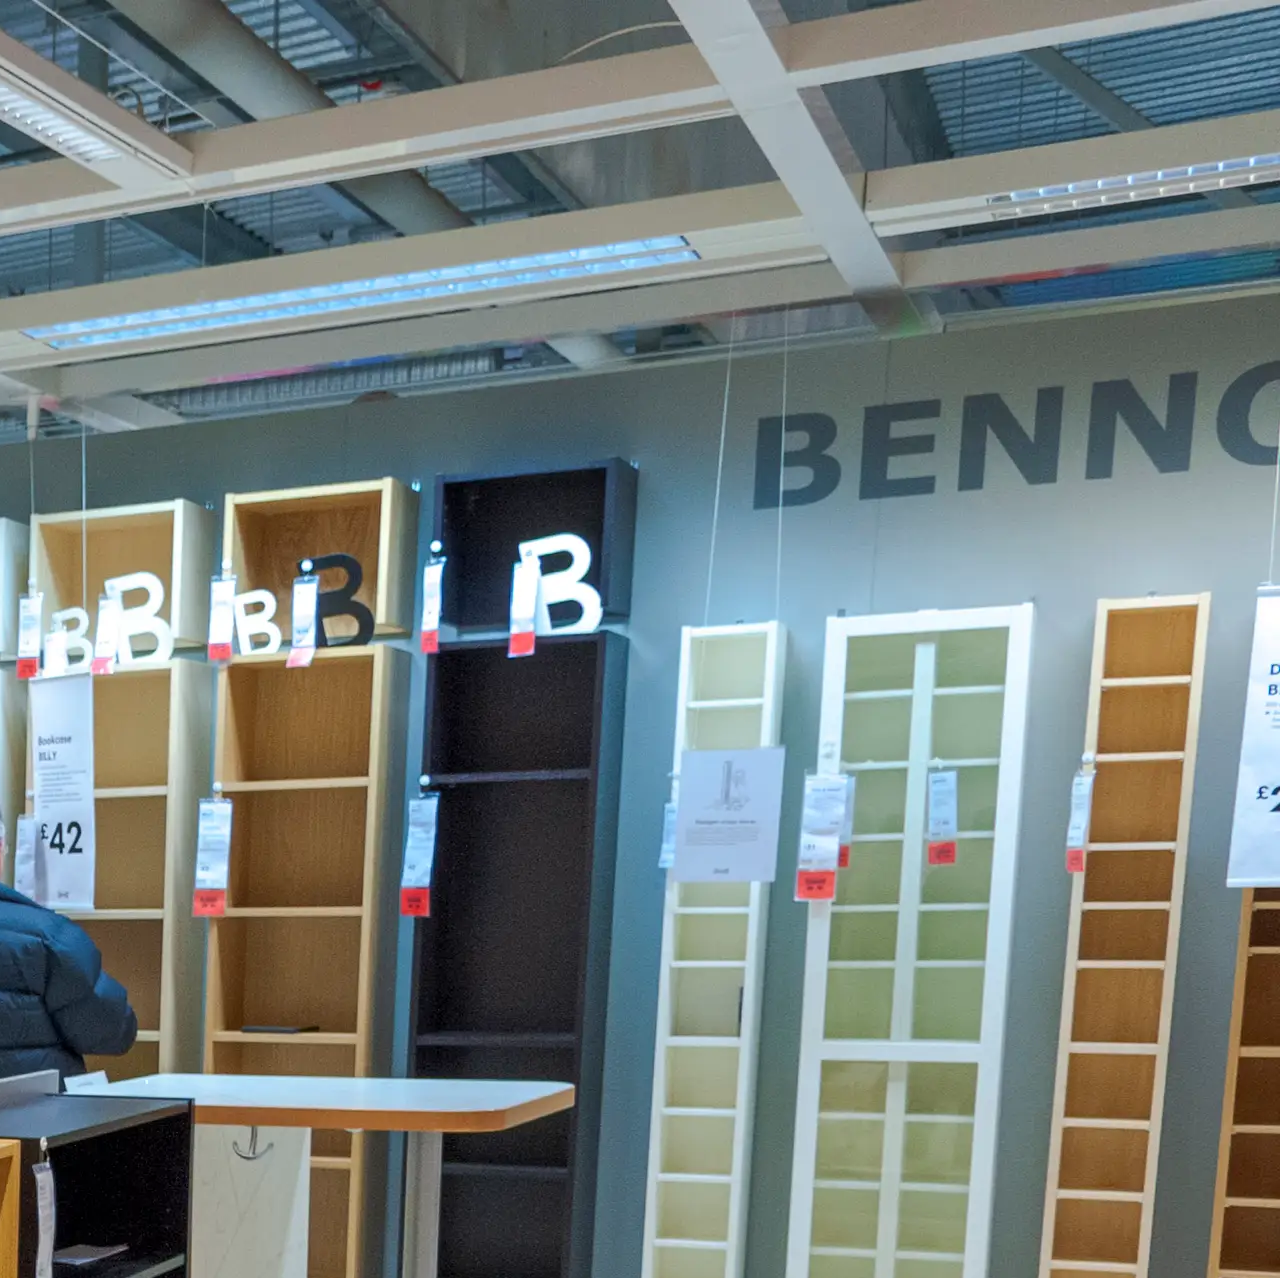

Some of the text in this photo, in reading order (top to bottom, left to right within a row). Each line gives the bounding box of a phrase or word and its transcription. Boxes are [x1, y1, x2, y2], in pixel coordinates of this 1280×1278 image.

[1268, 683, 1280, 696] B
[38, 735, 72, 746] Bookcase
[40, 821, 83, 855] £42
